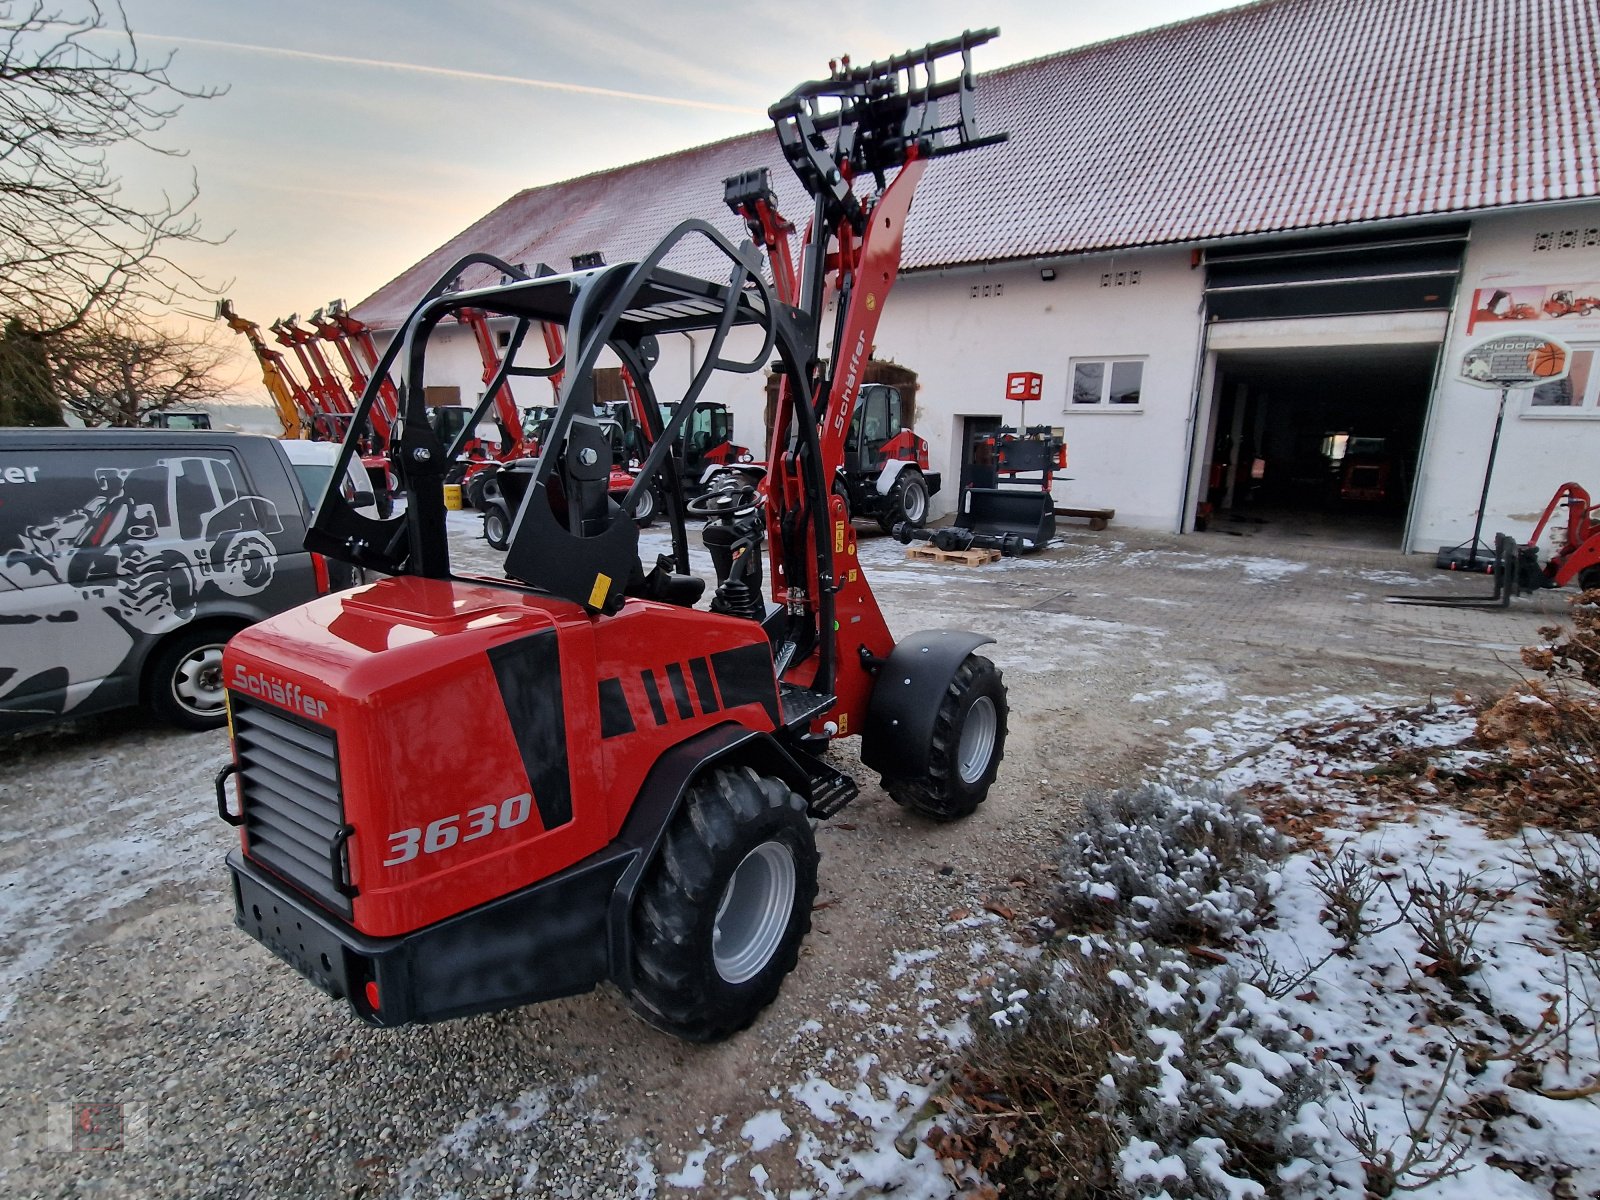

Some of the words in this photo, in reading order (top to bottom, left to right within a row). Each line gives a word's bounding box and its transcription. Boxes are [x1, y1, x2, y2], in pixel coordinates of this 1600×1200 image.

[1484, 342, 1547, 351] HUDORA
[833, 329, 867, 438] Schäffer
[232, 664, 329, 720] Schäffer
[383, 793, 532, 867] 3630
